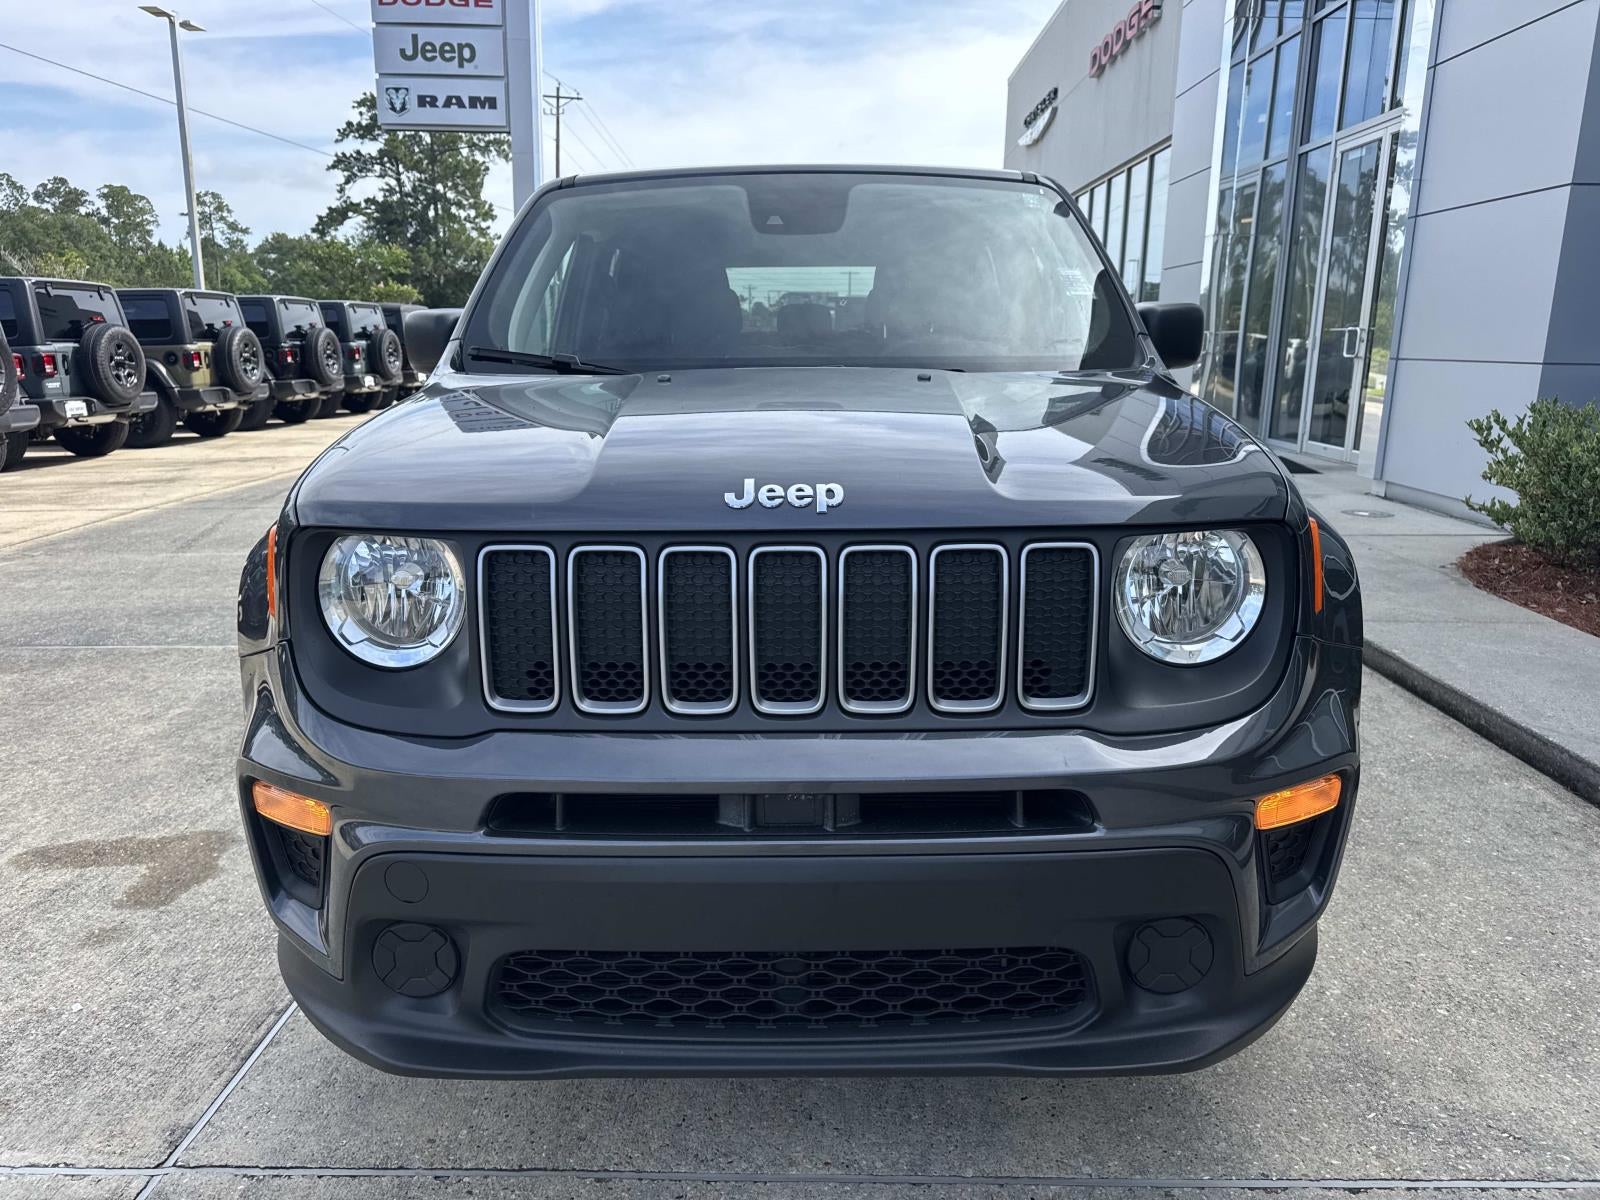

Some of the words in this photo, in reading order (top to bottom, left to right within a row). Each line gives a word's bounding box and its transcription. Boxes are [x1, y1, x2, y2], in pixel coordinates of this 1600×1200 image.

[400, 33, 476, 68] Jeep
[417, 94, 497, 110] RAM
[724, 478, 844, 513] Jeep
